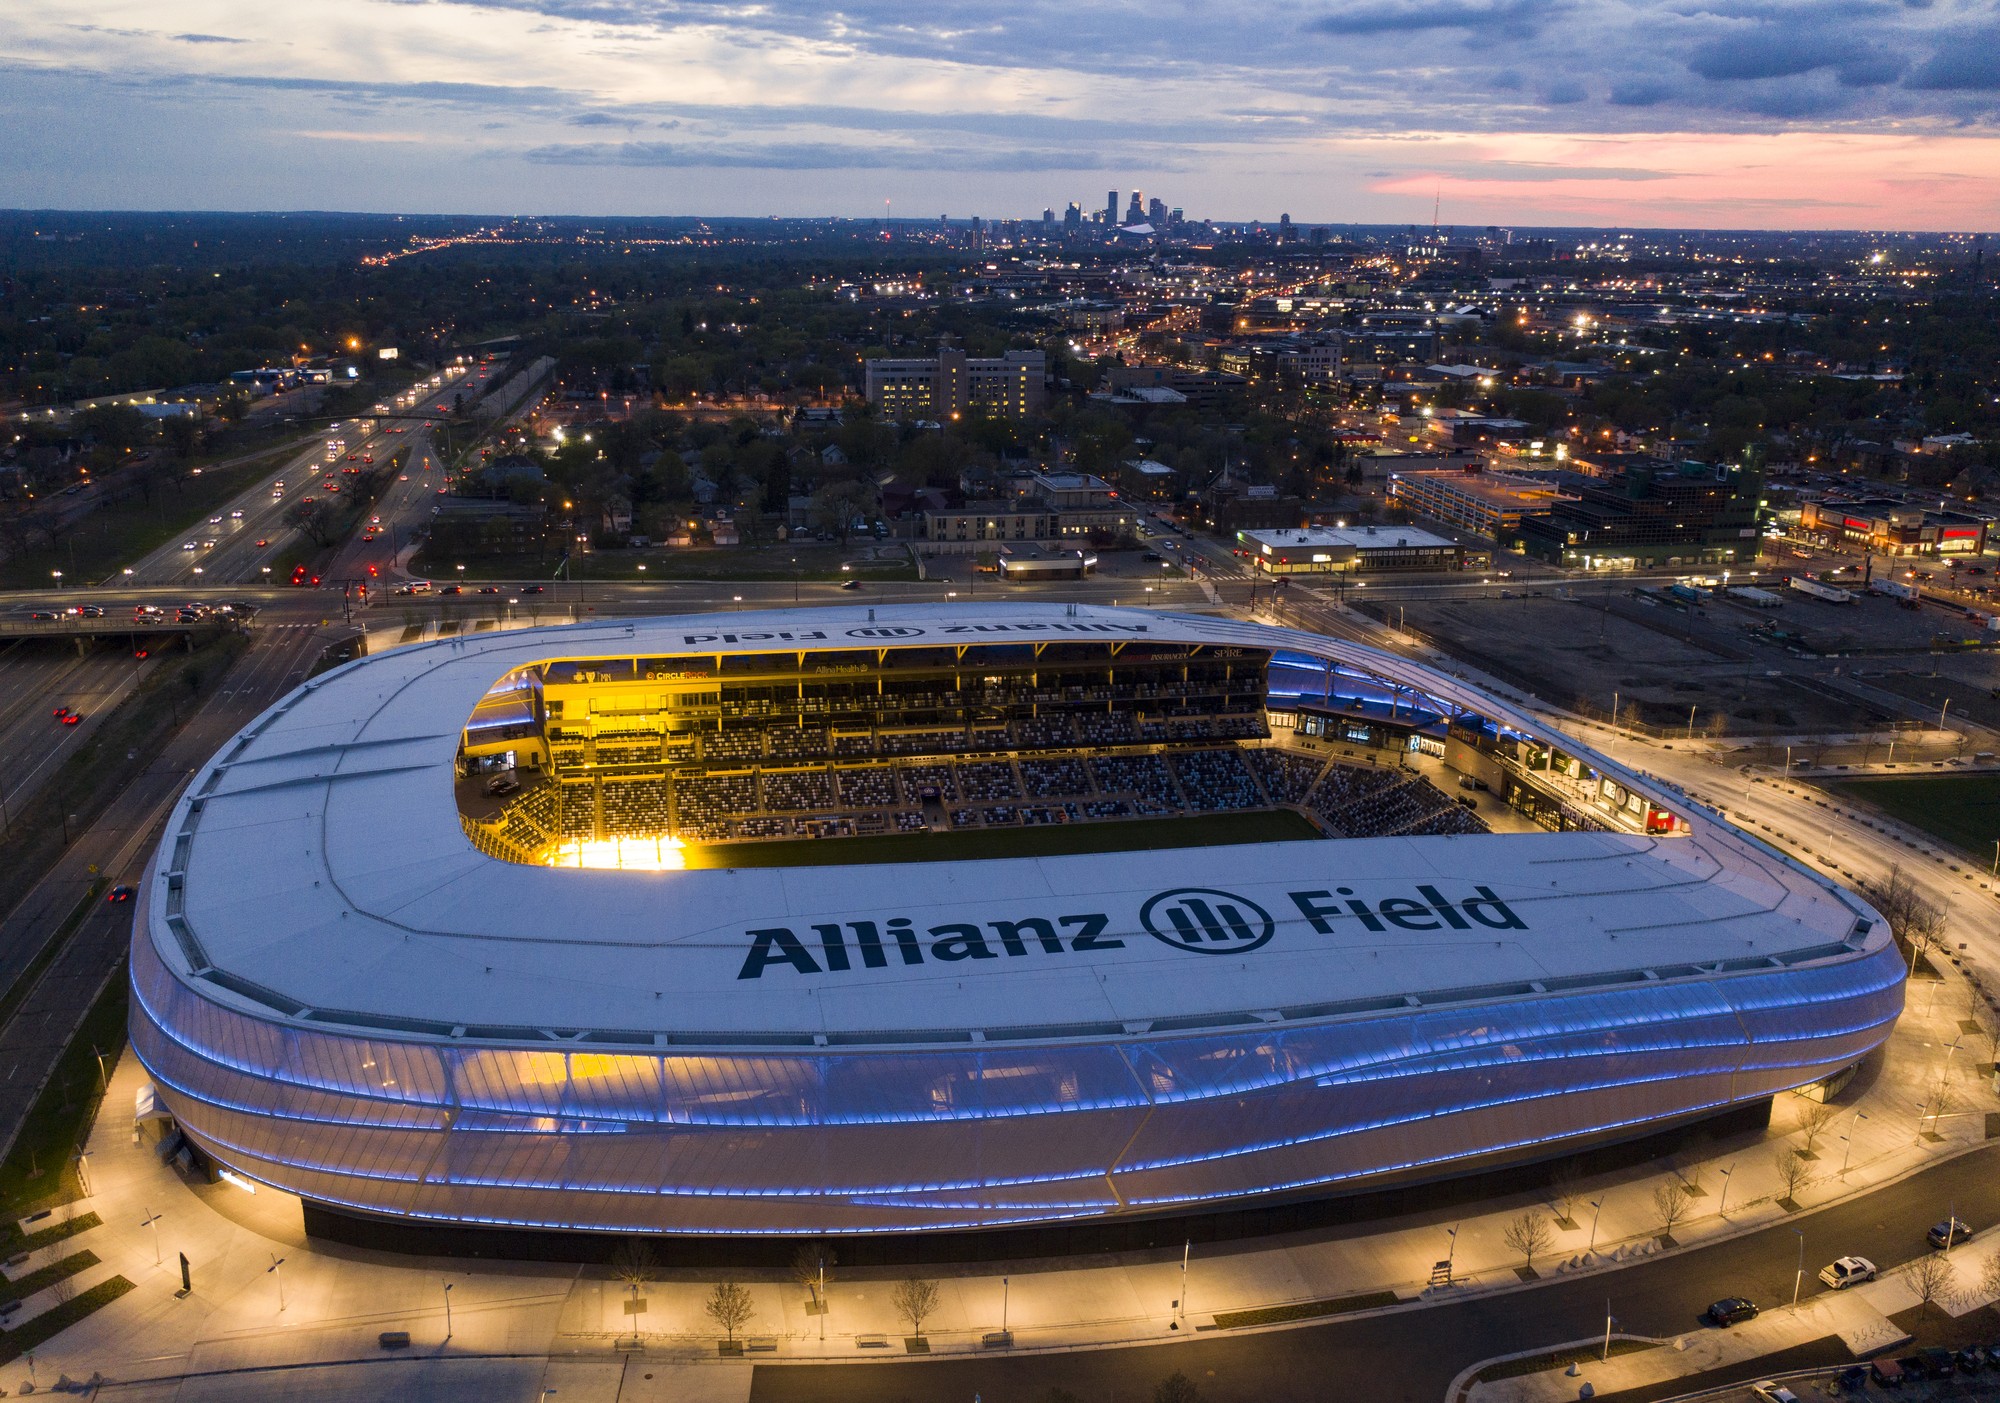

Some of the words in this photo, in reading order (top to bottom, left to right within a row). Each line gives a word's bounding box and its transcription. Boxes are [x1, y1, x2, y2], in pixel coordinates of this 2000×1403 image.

[944, 624, 1148, 633] Allianz
[684, 631, 826, 644] Field
[1213, 648, 1243, 658] SPIRE
[1561, 802, 1583, 825] BREW
[1584, 816, 1606, 832] HA
[736, 912, 1126, 980] Allianz
[1287, 884, 1529, 935] Field
